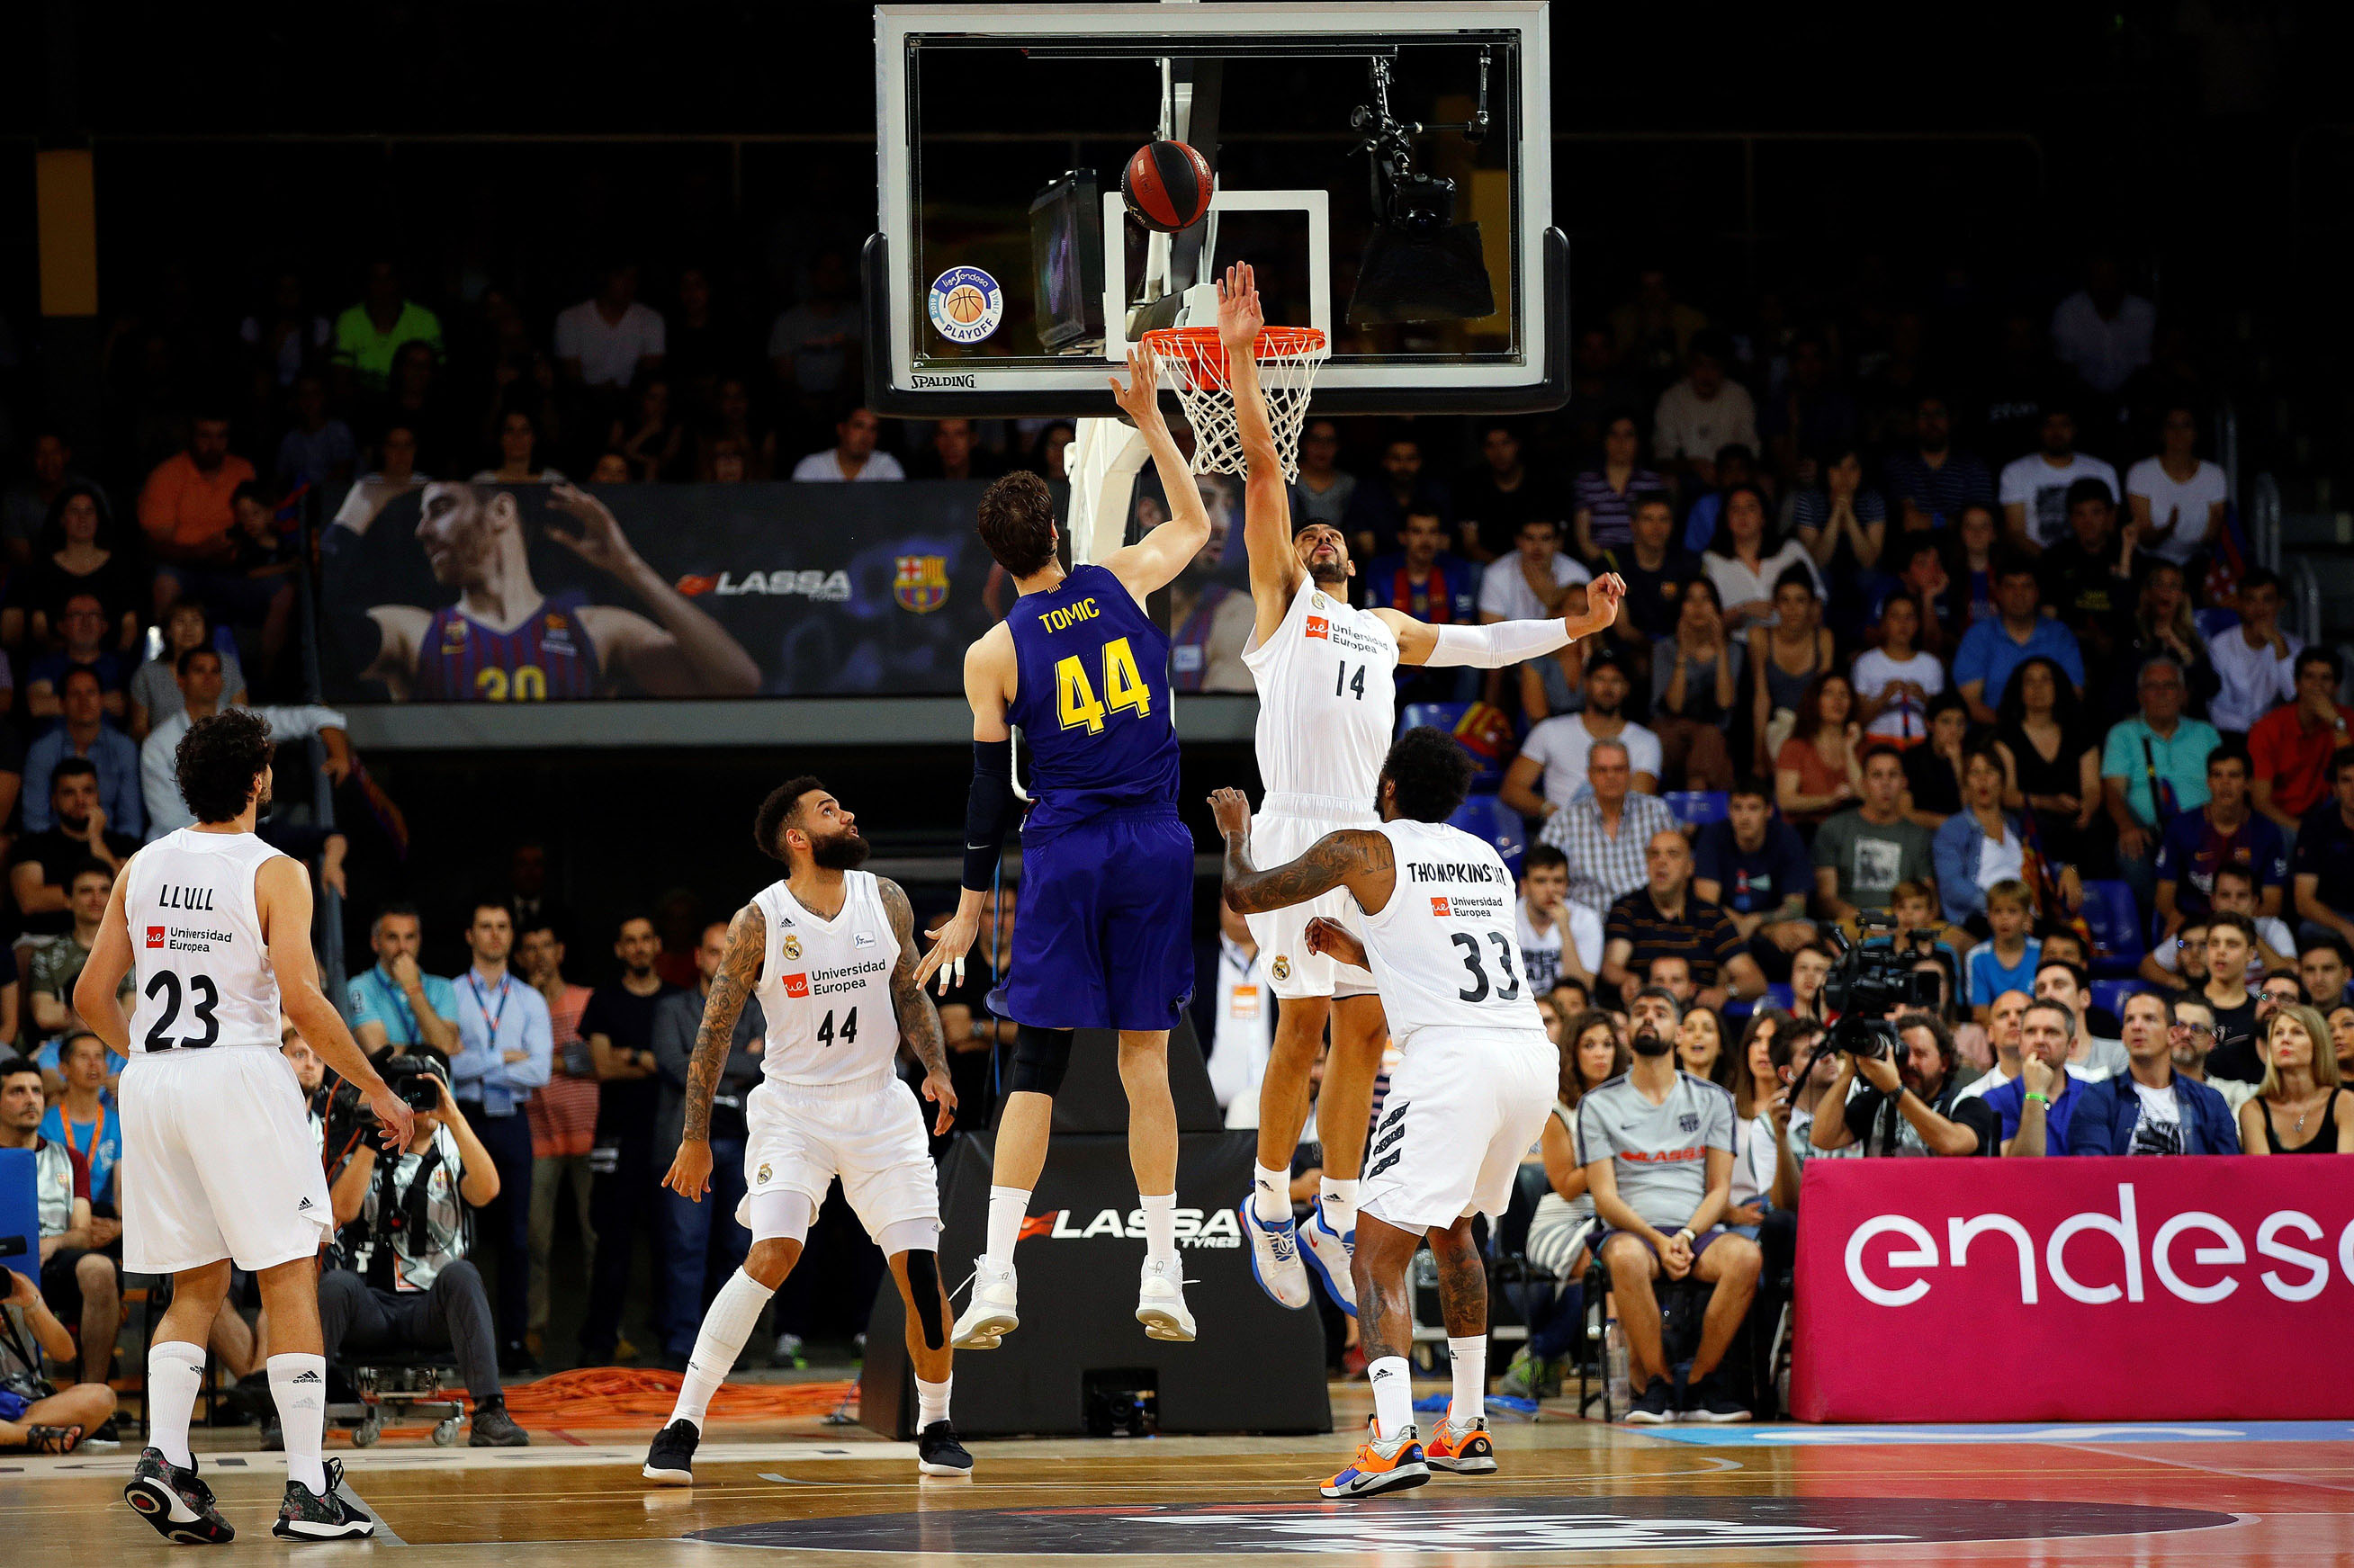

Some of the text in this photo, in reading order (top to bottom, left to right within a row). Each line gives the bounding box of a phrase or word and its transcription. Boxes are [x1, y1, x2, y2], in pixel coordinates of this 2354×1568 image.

[992, 291, 1001, 315] FINAL
[943, 318, 993, 340] PLAYOFF
[912, 374, 975, 390] SPALDING
[714, 569, 852, 596] LASSA
[1038, 597, 1101, 634] TOMIC
[1333, 633, 1378, 654] Europea
[1055, 637, 1151, 736] 44
[1336, 660, 1366, 701] 14
[1407, 863, 1493, 883] THOMPKINS
[159, 884, 214, 911] LLULL
[1451, 897, 1503, 907] Universidad
[1454, 908, 1492, 918] Europea
[169, 939, 211, 954] Europea
[170, 927, 233, 943] Universidad
[812, 959, 886, 981] Universidad
[1451, 931, 1520, 1003] 33
[813, 978, 867, 996] Europea
[144, 969, 220, 1053] 23
[817, 1006, 858, 1048] 44
[1051, 1208, 1242, 1239] LASSA
[1180, 1236, 1242, 1249] TYRES
[1844, 1182, 2354, 1307] endes
